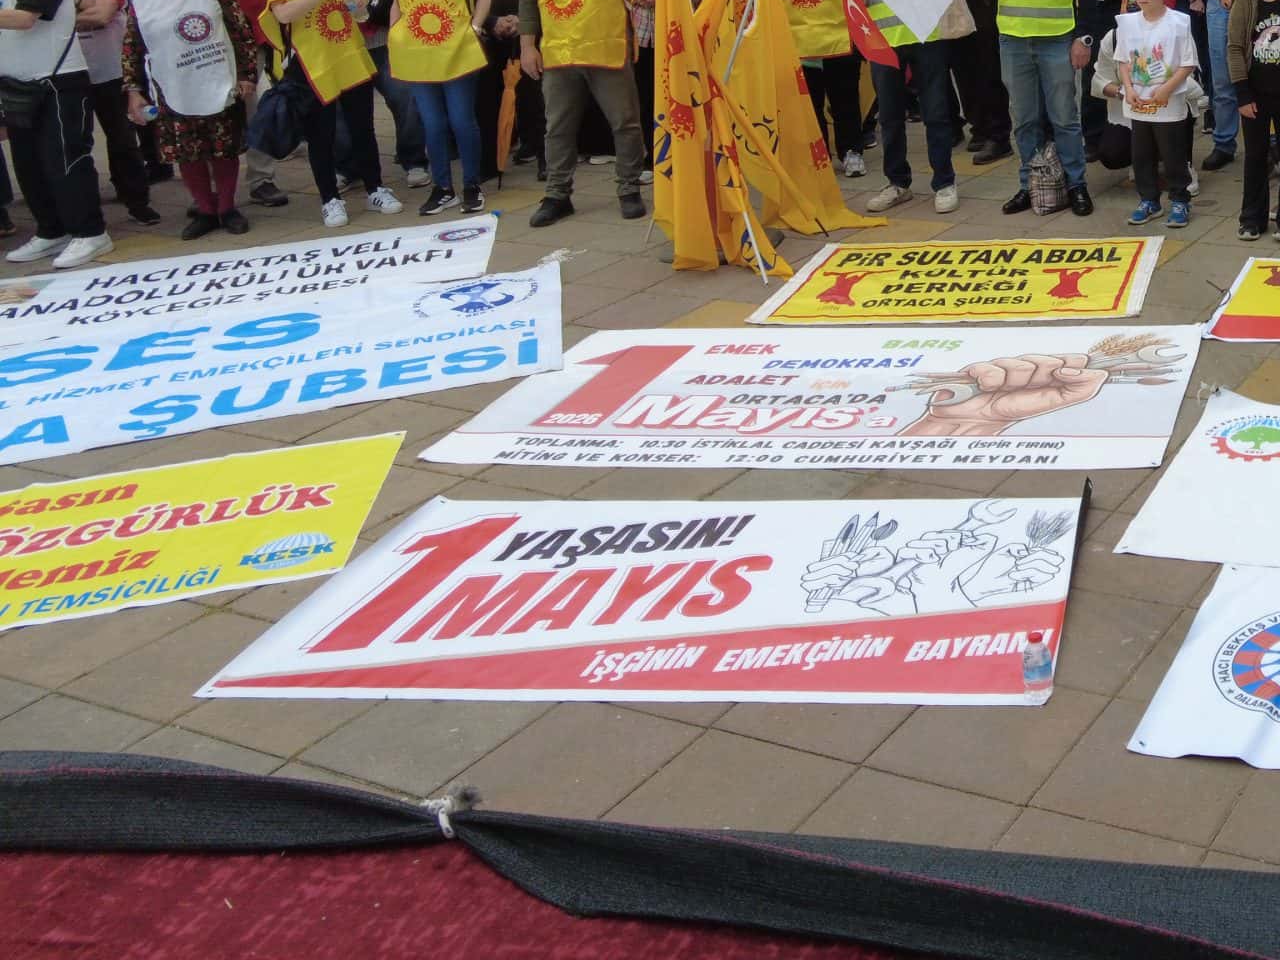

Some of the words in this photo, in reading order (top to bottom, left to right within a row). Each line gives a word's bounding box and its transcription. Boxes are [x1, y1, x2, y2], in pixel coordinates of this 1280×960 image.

[84, 267, 180, 291] HACI
[186, 248, 321, 276] BEKTAŞ
[331, 236, 402, 258] VELİ
[837, 251, 892, 269] PİR
[895, 248, 1018, 267] SULTAN
[1021, 246, 1123, 266] ABDAL
[0, 281, 196, 319] ANADOLU
[356, 248, 454, 271] VAKFI
[898, 265, 1030, 281] KÜLTÜR
[253, 274, 369, 302] ŞUBESİ
[861, 296, 947, 310] ORTACA
[952, 292, 1033, 308] ŞUBESİ
[881, 279, 1028, 296] DERNEĞİ
[0, 312, 322, 389] SES
[704, 343, 782, 357] EMEK
[881, 339, 966, 352] BARIŞ
[27, 374, 161, 406] HİZMET
[168, 342, 363, 383] EMEKÇİLERİ
[374, 319, 536, 352] SENDİKASI
[762, 354, 925, 370] DEMOKRASİ
[119, 331, 538, 440] ŞUBESİ
[684, 374, 800, 387] ADALET
[728, 392, 887, 406] ORTACA'DA
[612, 394, 898, 434] Mayıs'a
[496, 449, 568, 463] MİTİNG
[573, 452, 608, 463] VE
[612, 452, 703, 464] KONSER:
[725, 453, 785, 465] 12:00
[794, 452, 942, 465] CUMHURİYET
[952, 453, 1059, 465] MEYDANI
[515, 436, 624, 449] TOPLANMA:
[690, 438, 783, 451] İSTİKLAL
[782, 438, 866, 450] CADDESİ
[869, 437, 956, 450] KAVŞAĞI
[237, 541, 336, 567] KESK
[18, 563, 224, 617] TEMSİCİLİĞİ
[300, 512, 523, 654] 1
[491, 513, 757, 568] YAŞASIN!
[392, 554, 774, 645] MAYIS
[1223, 622, 1267, 657] BEKTAŞ
[580, 641, 702, 684] İŞÇİNİN
[712, 634, 895, 673] EMEKÇİNİN
[1218, 658, 1231, 684] HACI
